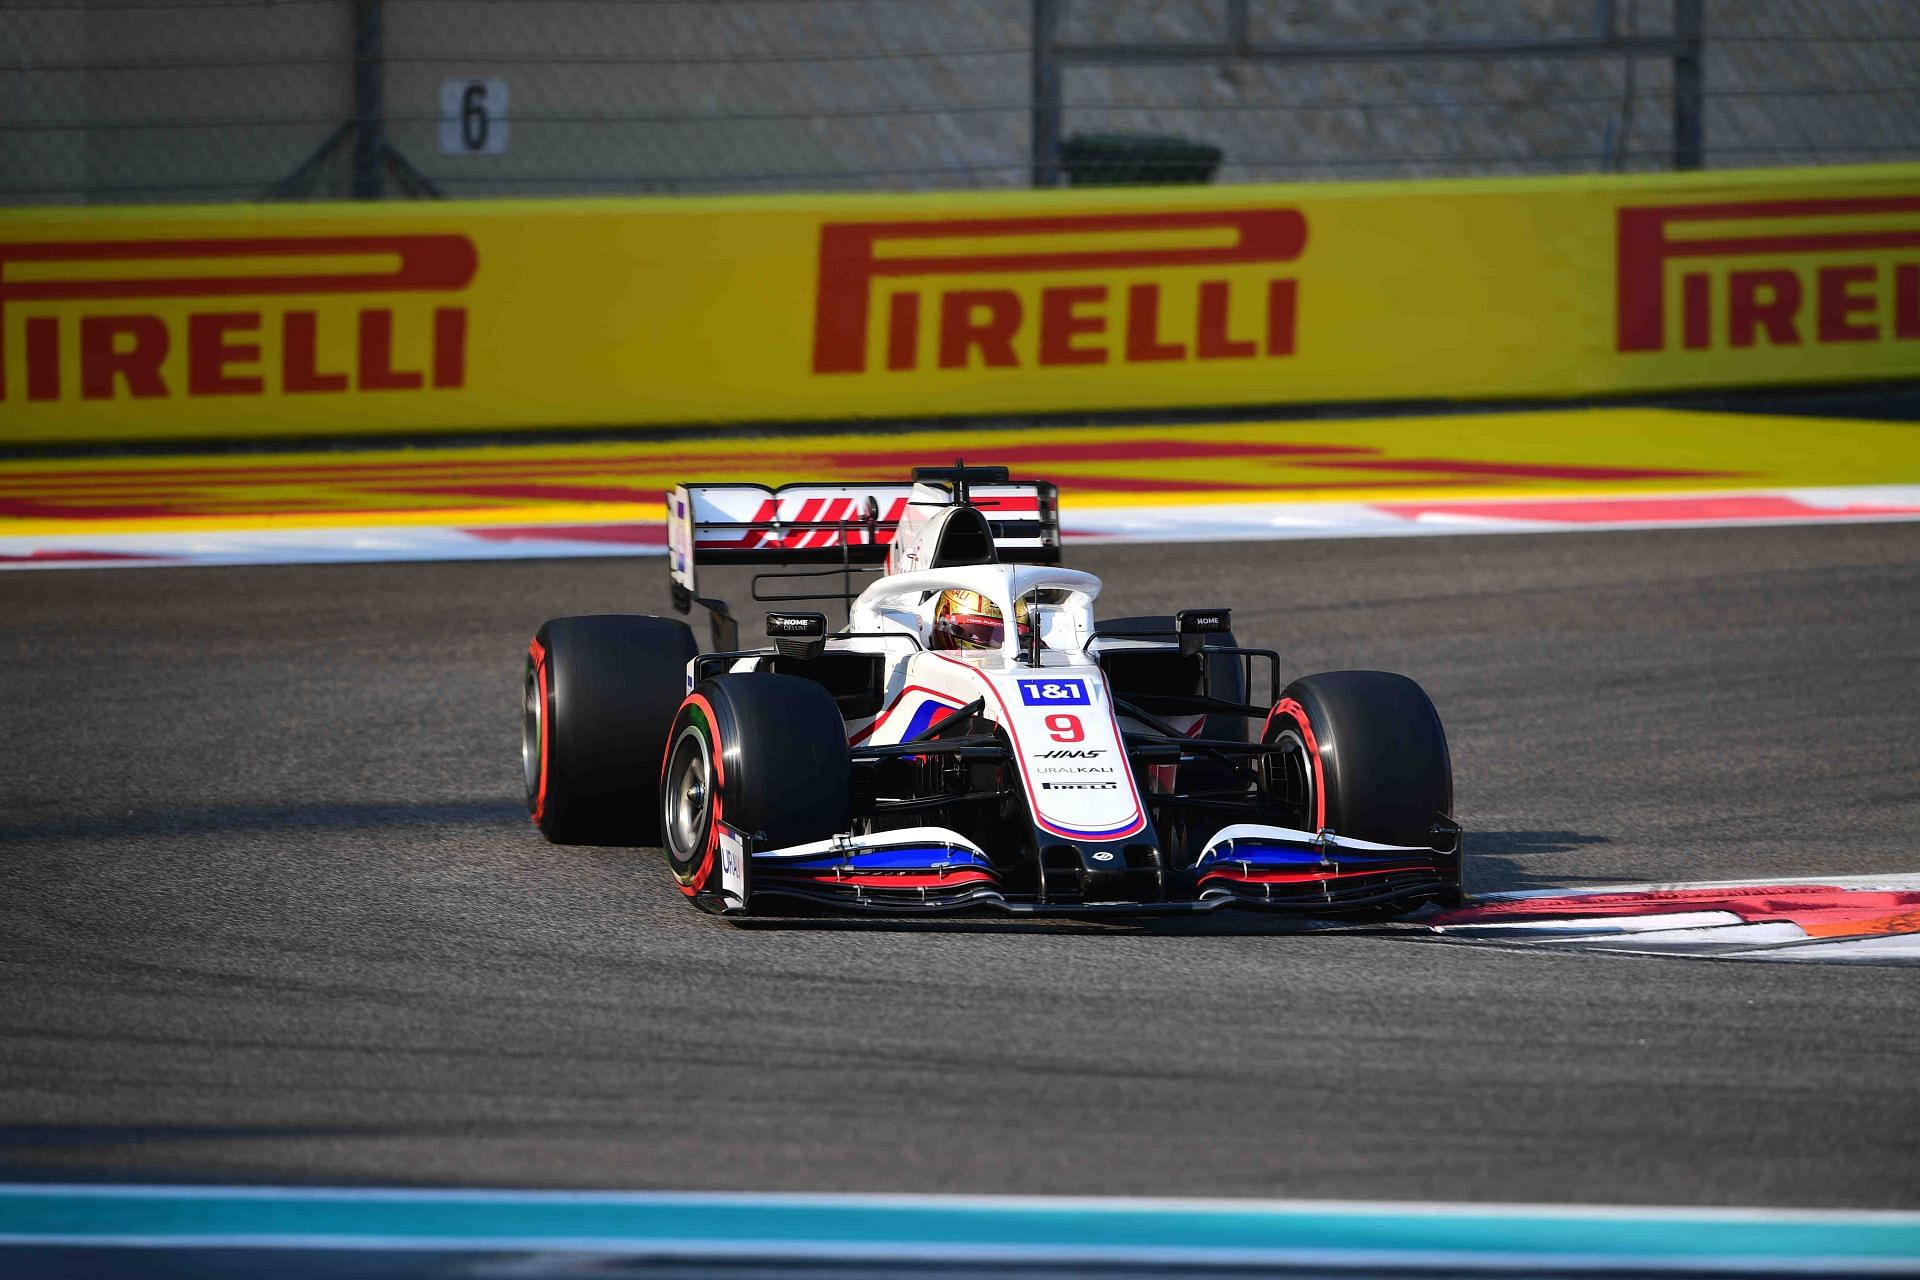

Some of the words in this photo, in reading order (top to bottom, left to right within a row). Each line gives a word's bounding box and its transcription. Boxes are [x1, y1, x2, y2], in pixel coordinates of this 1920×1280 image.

[461, 80, 489, 151] 6
[812, 208, 1309, 376] PIRELLI
[1024, 683, 1081, 699] 1&1
[1044, 713, 1085, 743] 9
[1033, 750, 1108, 759] HAAS
[1041, 782, 1118, 790] PIRELLI
